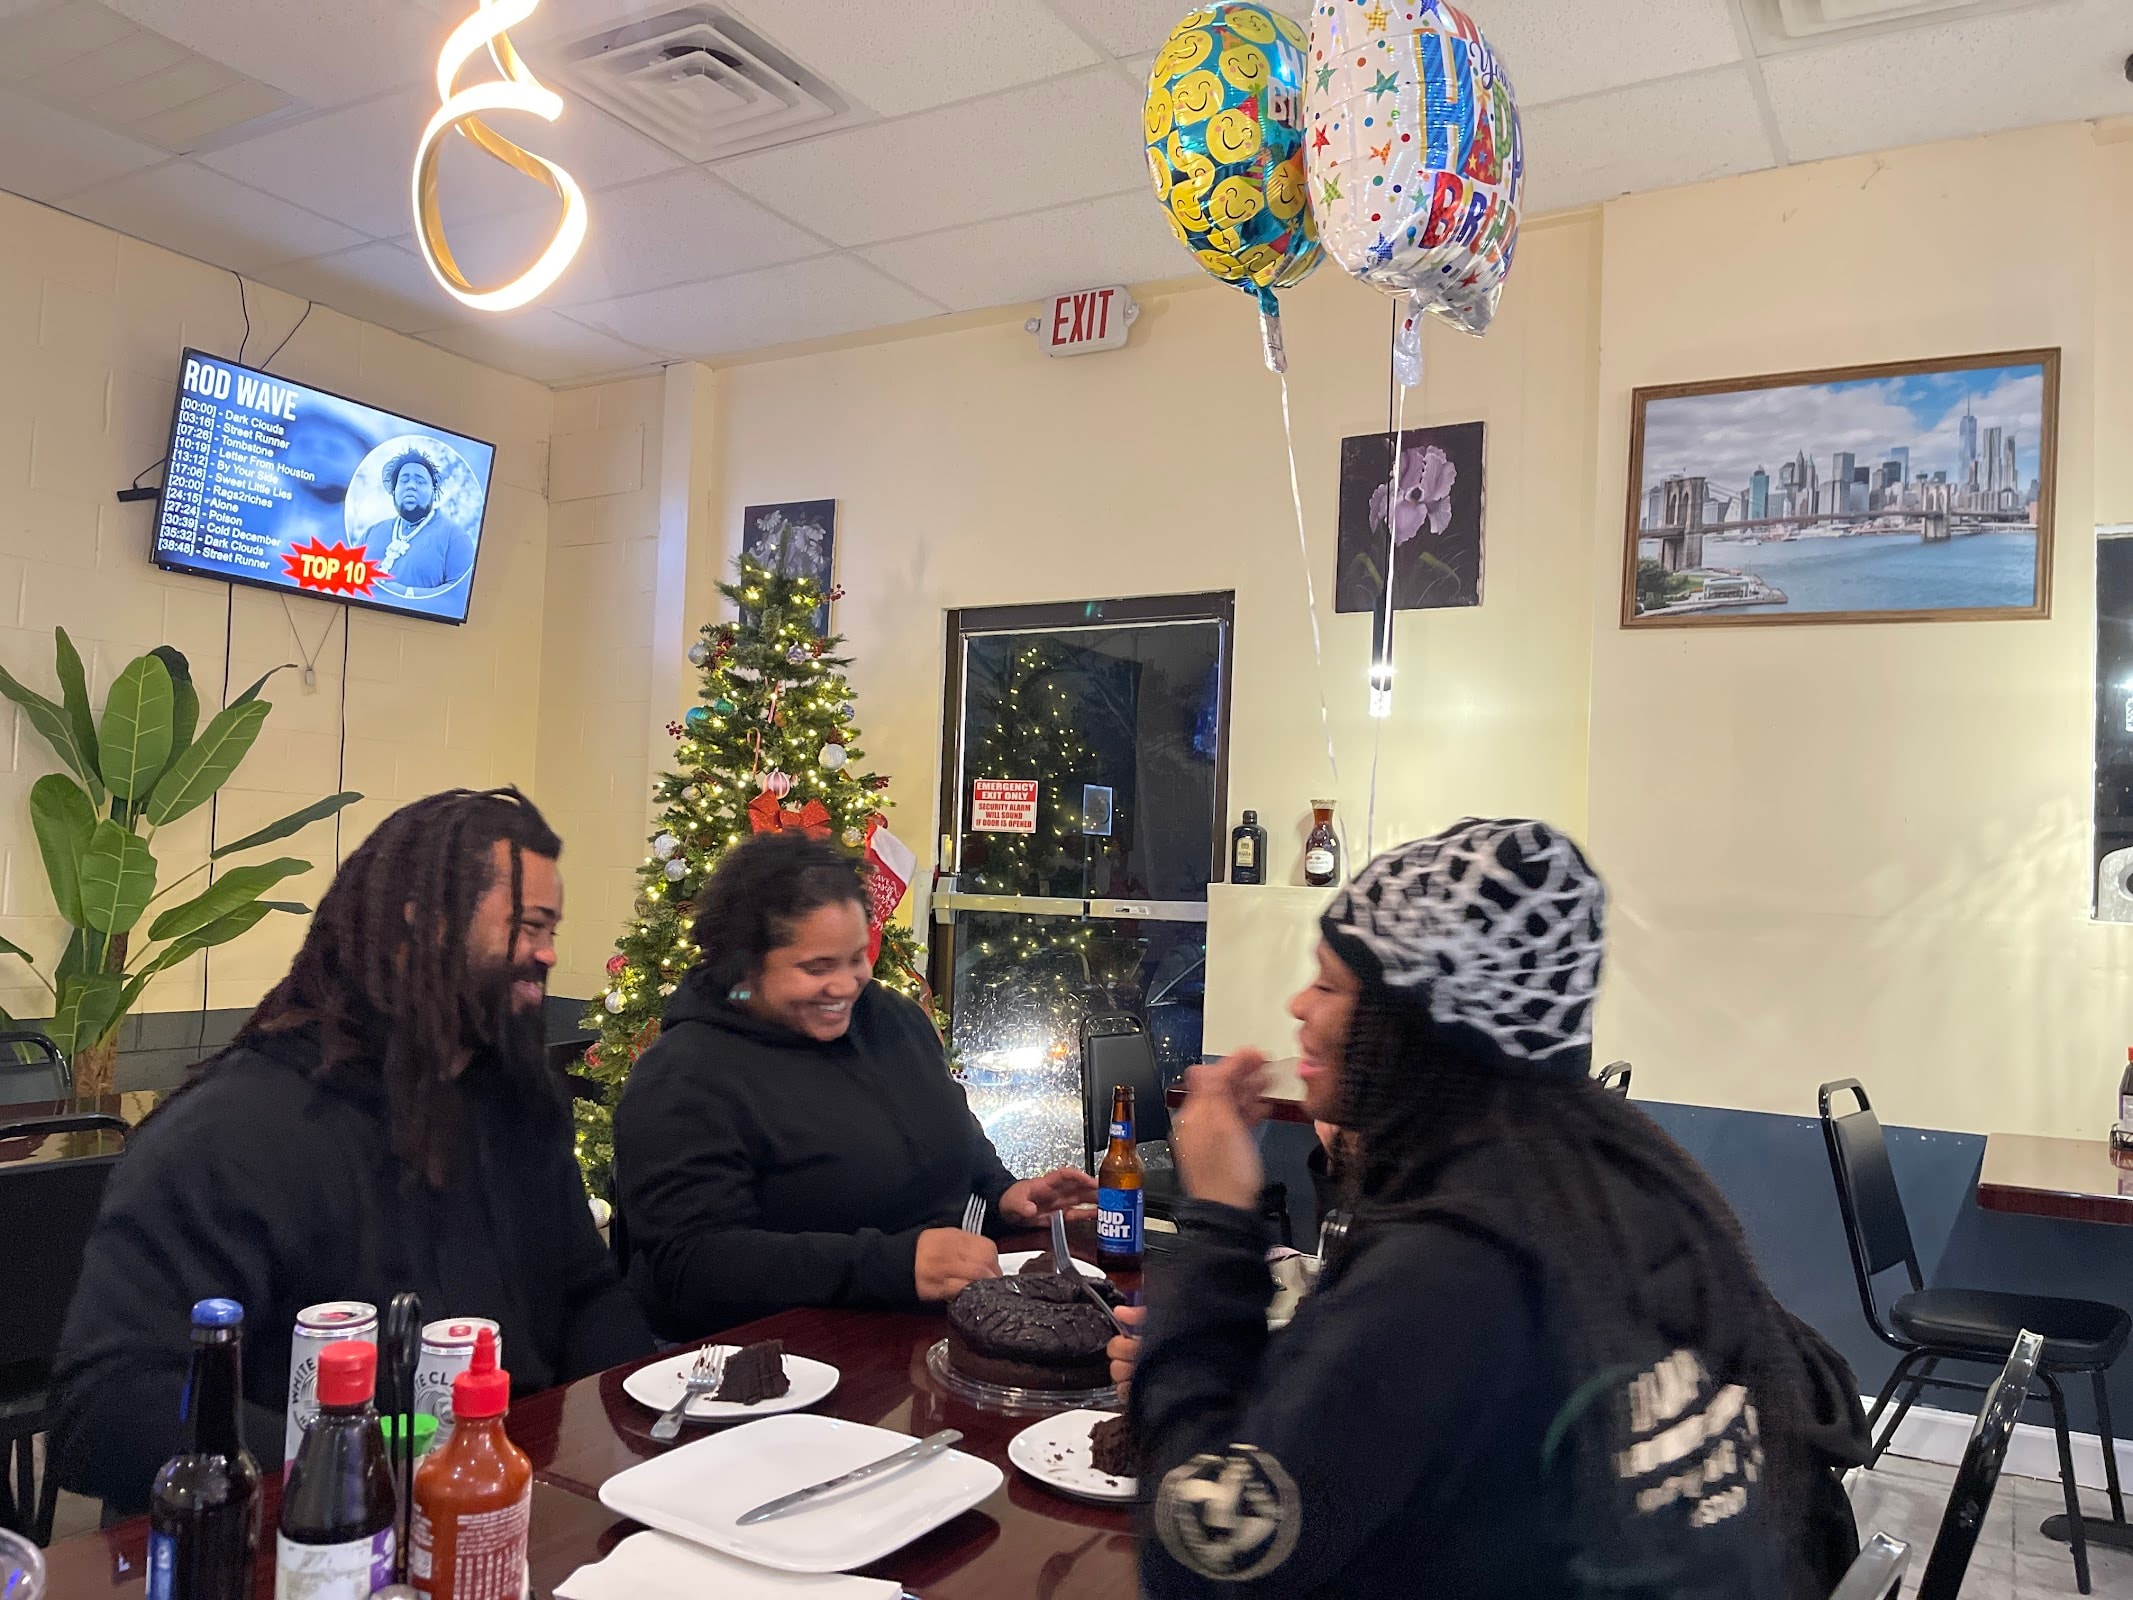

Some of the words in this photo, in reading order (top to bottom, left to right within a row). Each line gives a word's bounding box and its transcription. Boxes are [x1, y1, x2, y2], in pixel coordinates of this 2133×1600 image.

[1052, 290, 1114, 346] EXIT
[183, 359, 232, 400] ROD
[236, 374, 299, 421] WAVE
[179, 410, 214, 431] [03:16]
[223, 422, 253, 440] Street
[255, 430, 290, 449] Runner
[181, 397, 216, 418] [00:00]
[225, 409, 249, 425] Dark
[250, 417, 285, 436] Clouds
[176, 422, 212, 443] [07:26]
[221, 434, 274, 458] Tombstone
[172, 449, 208, 469] [13:12]
[217, 460, 231, 474] By
[233, 463, 256, 478] Your
[256, 470, 279, 485] Side
[175, 436, 210, 456] [10:19]
[219, 447, 248, 464] Letter
[250, 455, 275, 470] From
[276, 462, 315, 482] Houston
[168, 474, 205, 494] [20:00]
[213, 484, 273, 508] Rags2riches
[171, 461, 207, 481] [17:06]
[215, 472, 247, 489] Sweet
[247, 481, 271, 495] Little
[272, 486, 293, 500] Lies
[164, 499, 201, 519] [27:24]
[208, 509, 243, 527] Poison
[166, 487, 202, 507] [24:15]
[209, 497, 239, 513] Alone
[160, 525, 197, 544] [35:32]
[204, 534, 229, 549] Dark
[231, 540, 264, 556] Clouds
[162, 512, 198, 532] [30:39]
[207, 522, 231, 536] Cold
[232, 527, 282, 547] December
[158, 538, 195, 557] [38:48]
[202, 546, 233, 563] Street
[234, 553, 271, 570] Runner
[301, 554, 340, 580] TOP
[344, 560, 366, 585] 10
[976, 782, 1035, 792] EMERGENCY
[981, 791, 1003, 800] EXIT
[1004, 791, 1029, 801] ONLY
[976, 819, 982, 827] IF
[982, 819, 999, 827] DOOR
[1008, 820, 1032, 828] OPENED
[978, 803, 1008, 811] SECURITY
[985, 811, 1000, 819] WILL
[1001, 812, 1023, 820] SOUND
[1098, 1209, 1125, 1226] BUD
[292, 1357, 316, 1404] WHITE
